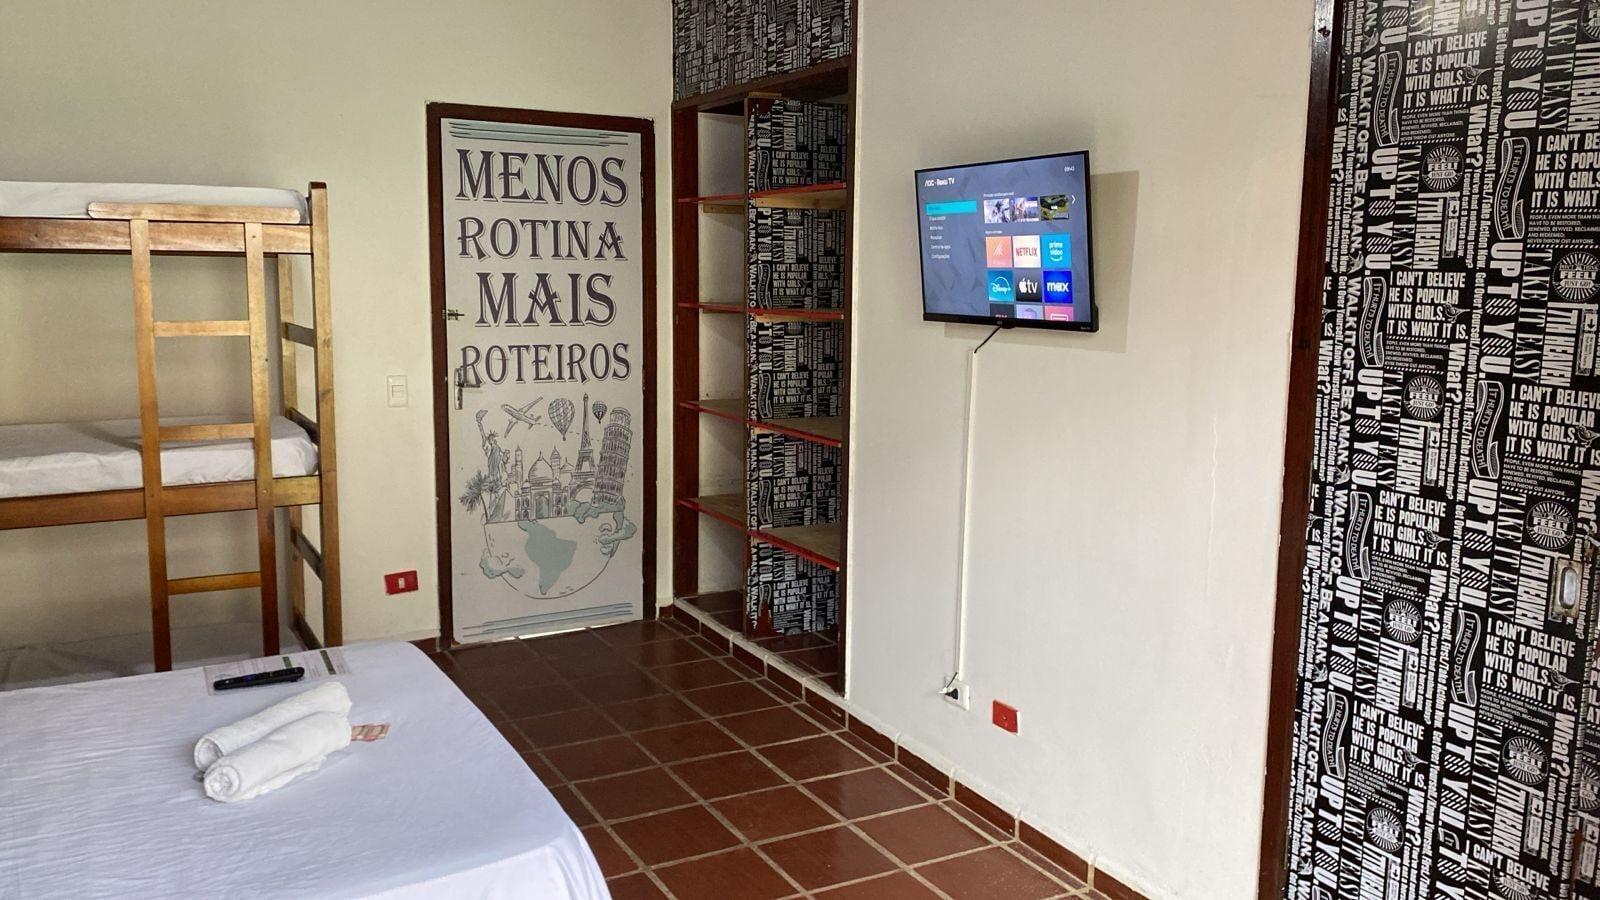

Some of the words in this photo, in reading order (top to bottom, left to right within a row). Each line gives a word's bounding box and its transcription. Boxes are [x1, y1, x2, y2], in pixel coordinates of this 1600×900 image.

[1407, 43, 1411, 57] I
[1415, 38, 1443, 56] CAN'T
[1446, 31, 1487, 52] BELIEVE
[1406, 59, 1419, 75] HE
[1422, 57, 1432, 73] IS
[1436, 50, 1480, 71] POPULAR
[1403, 93, 1413, 109] IT
[1416, 92, 1426, 107] IS
[1431, 88, 1459, 106] WHAT
[1463, 86, 1473, 102] IT
[1476, 85, 1490, 101] IS.
[1406, 74, 1431, 91] WITH
[1434, 70, 1466, 88] GIRLS.
[1355, 130, 1370, 169] OFF.
[1466, 104, 1488, 167] What?
[455, 149, 629, 207] MENOS
[1372, 147, 1399, 181] UP
[1396, 145, 1422, 194] TAKE
[1508, 156, 1520, 184] HURTS
[1355, 170, 1369, 194] BE
[1502, 186, 1512, 198] TO
[1353, 196, 1365, 209] A
[1395, 200, 1418, 217] IT
[457, 216, 628, 262] ROTINA
[1049, 241, 1063, 249] prime
[1349, 211, 1364, 253] MAN.
[1392, 224, 1416, 270] EASY
[1413, 223, 1441, 270] HEAVEN
[1016, 247, 1038, 257] NETFLIX
[1490, 243, 1524, 277] UP
[1047, 282, 1069, 292] max
[1390, 271, 1393, 286] I
[1397, 271, 1423, 286] CAN'T
[1427, 272, 1466, 288] BELIEVE
[1475, 272, 1486, 287] Get
[1521, 249, 1553, 300] TAKE
[1560, 271, 1596, 280] FEEL!
[475, 272, 617, 328] MAIS
[1388, 304, 1411, 319] WITH
[1415, 305, 1445, 320] GIRLS.
[1389, 288, 1400, 302] HE
[1403, 288, 1413, 303] IS
[1417, 288, 1459, 304] POPULAR
[1474, 288, 1485, 308] Over
[1387, 320, 1395, 334] IT
[1398, 320, 1407, 335] IS
[1411, 321, 1440, 337] WHAT
[1442, 323, 1452, 338] IT
[1456, 324, 1469, 339] IS.
[1518, 307, 1547, 328] IT
[460, 343, 631, 386] ROTEIROS
[1446, 342, 1467, 403] What?
[1512, 333, 1544, 384] EASY
[1540, 335, 1575, 387] HEAVEN
[1357, 368, 1384, 401] UP
[1511, 384, 1516, 399] I
[1520, 385, 1552, 404] CAN'T
[1509, 401, 1524, 418] HE
[1528, 404, 1540, 420] IS
[1543, 406, 1596, 428] POPULAR
[1509, 419, 1538, 438] WITH
[1541, 424, 1578, 444] GIRLS.
[1506, 436, 1517, 452] IT
[1521, 438, 1532, 455] IS
[1537, 441, 1570, 460] WHAT
[1574, 446, 1586, 464] IT
[1458, 455, 1470, 482] Action
[1468, 479, 1499, 515] UP
[1486, 634, 1500, 652] HE
[1503, 639, 1515, 656] IS
[1518, 644, 1568, 673] POPULAR
[1487, 618, 1492, 633] I
[1496, 620, 1527, 643] CAN'T
[1530, 630, 1576, 658] BELIEVE
[1485, 651, 1513, 674] WITH
[1516, 662, 1551, 687] GIRLS.
[1482, 667, 1493, 684] IT
[1497, 672, 1508, 689] IS
[1512, 676, 1544, 701] WHAT
[1547, 689, 1559, 706] IT
[1563, 693, 1577, 713] IS.
[1353, 715, 1364, 732] HE
[1367, 721, 1376, 736] IS
[1379, 726, 1418, 754] POPULAR
[1354, 700, 1357, 714] I
[1361, 703, 1385, 724] CAN'T
[1388, 713, 1425, 740] BELIEVE
[1448, 702, 1476, 741] UP
[1352, 730, 1374, 751] WITH
[1377, 741, 1405, 765] GIRLS.
[1552, 713, 1575, 778] What?
[1350, 744, 1359, 760] IT
[1361, 750, 1370, 764] IS
[1374, 754, 1400, 777] WHAT
[1402, 767, 1411, 782] IT
[1415, 772, 1427, 790] IS.
